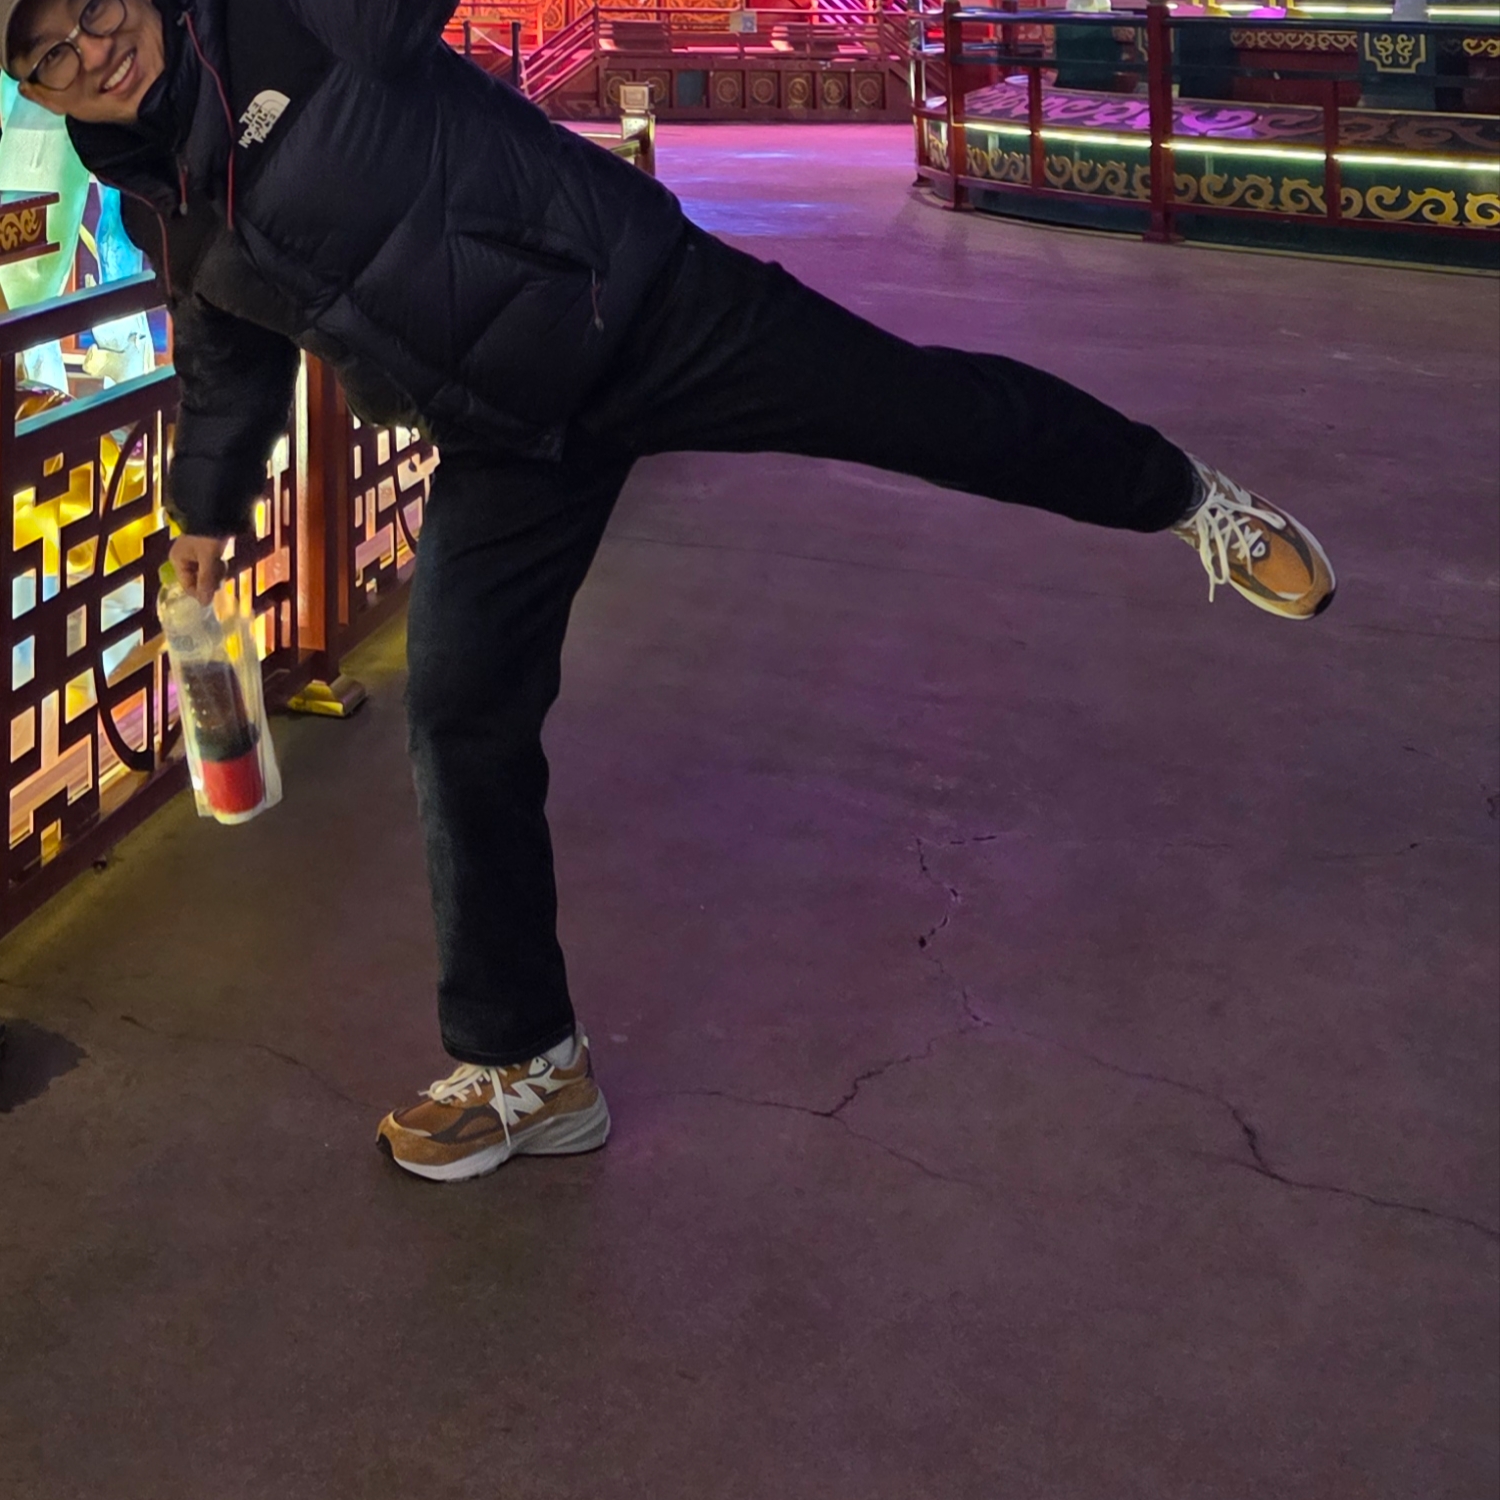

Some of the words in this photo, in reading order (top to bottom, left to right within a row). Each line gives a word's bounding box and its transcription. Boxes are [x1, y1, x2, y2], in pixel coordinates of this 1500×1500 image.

[238, 101, 260, 123] THE
[238, 109, 268, 148] NORTH
[254, 113, 279, 143] FACE
